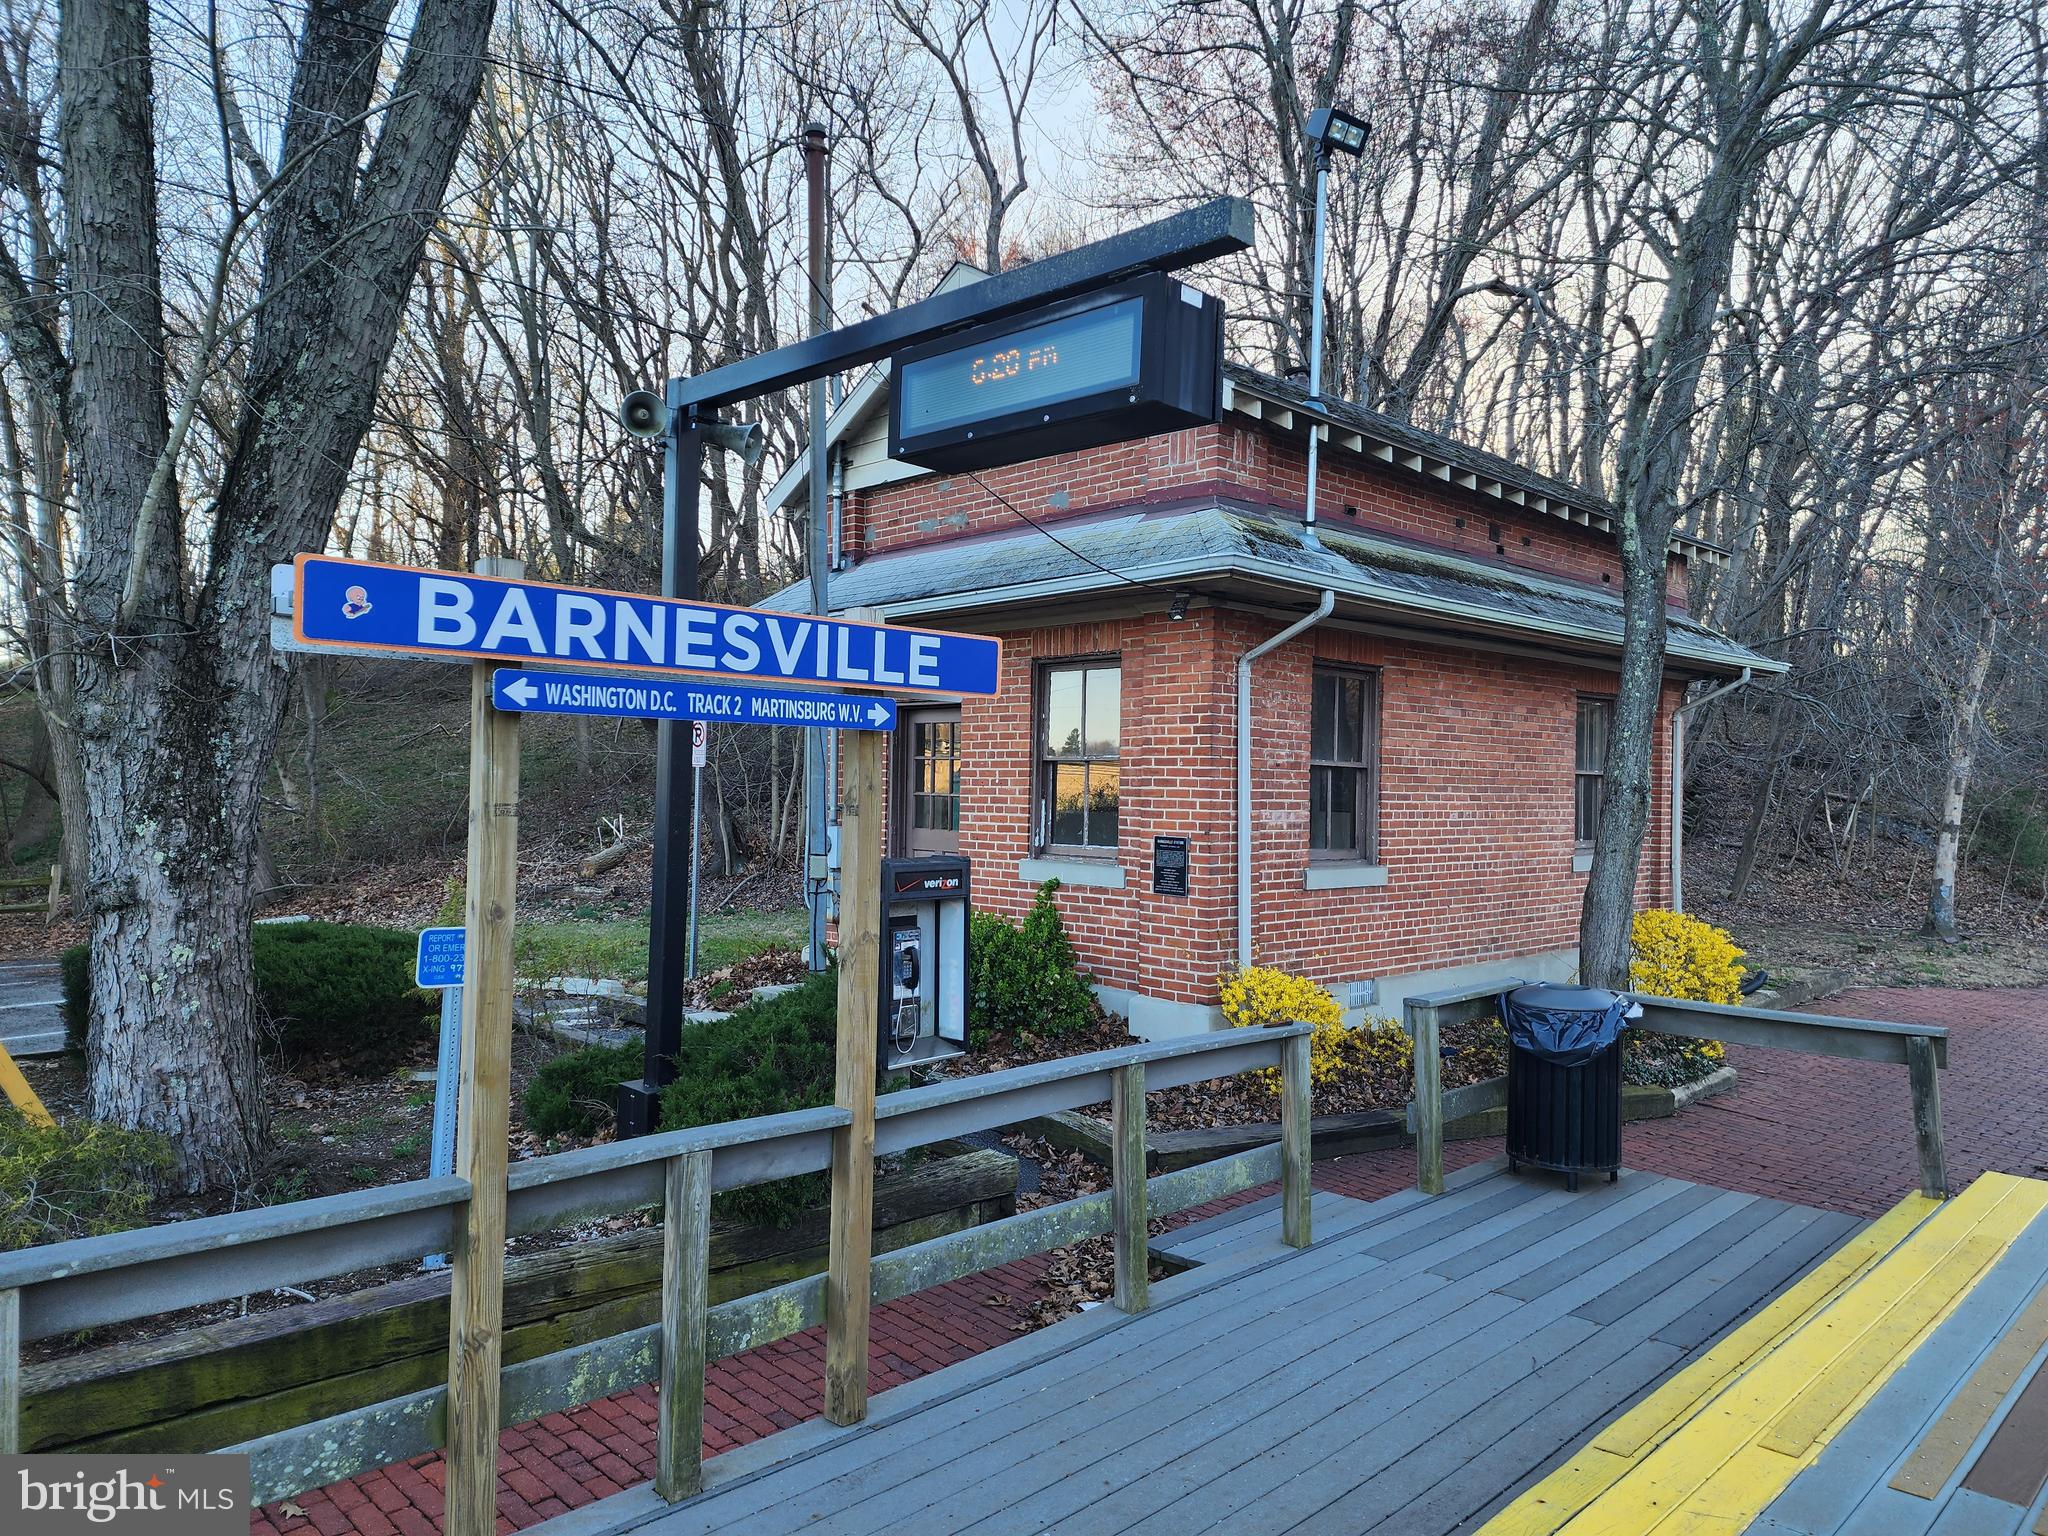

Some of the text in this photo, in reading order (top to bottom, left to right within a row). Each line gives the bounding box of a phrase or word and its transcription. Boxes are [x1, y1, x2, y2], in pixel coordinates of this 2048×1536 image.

[416, 577, 941, 688] BARNESVILLE
[544, 682, 863, 723] WASHINGTON D.C. TRACK 2 MARTINSBURG W.V.
[924, 876, 959, 889] verizon
[428, 934, 455, 943] REPORT
[428, 944, 441, 953] OR
